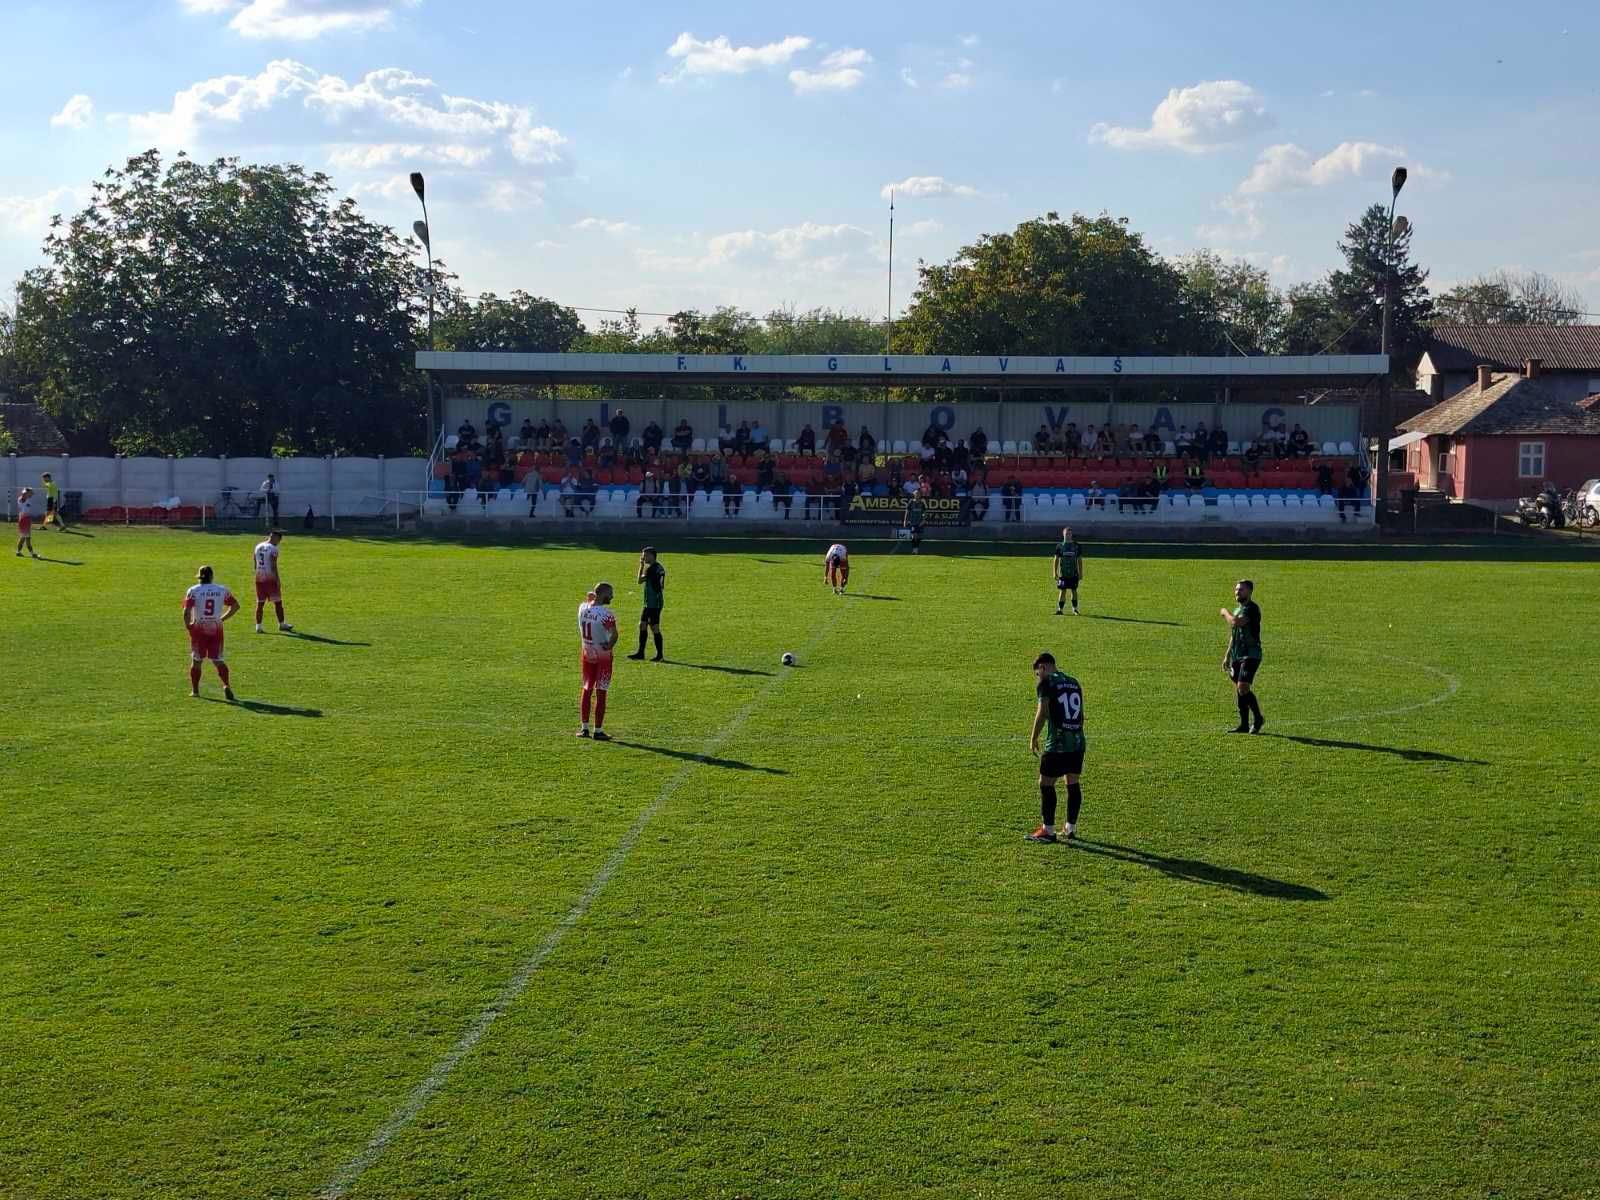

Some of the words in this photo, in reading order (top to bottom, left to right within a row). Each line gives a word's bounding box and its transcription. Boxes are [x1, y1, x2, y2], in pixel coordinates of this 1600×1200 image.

[848, 495, 960, 511] AMBASADOR
[204, 599, 215, 616] 9
[1057, 692, 1081, 720] 19
